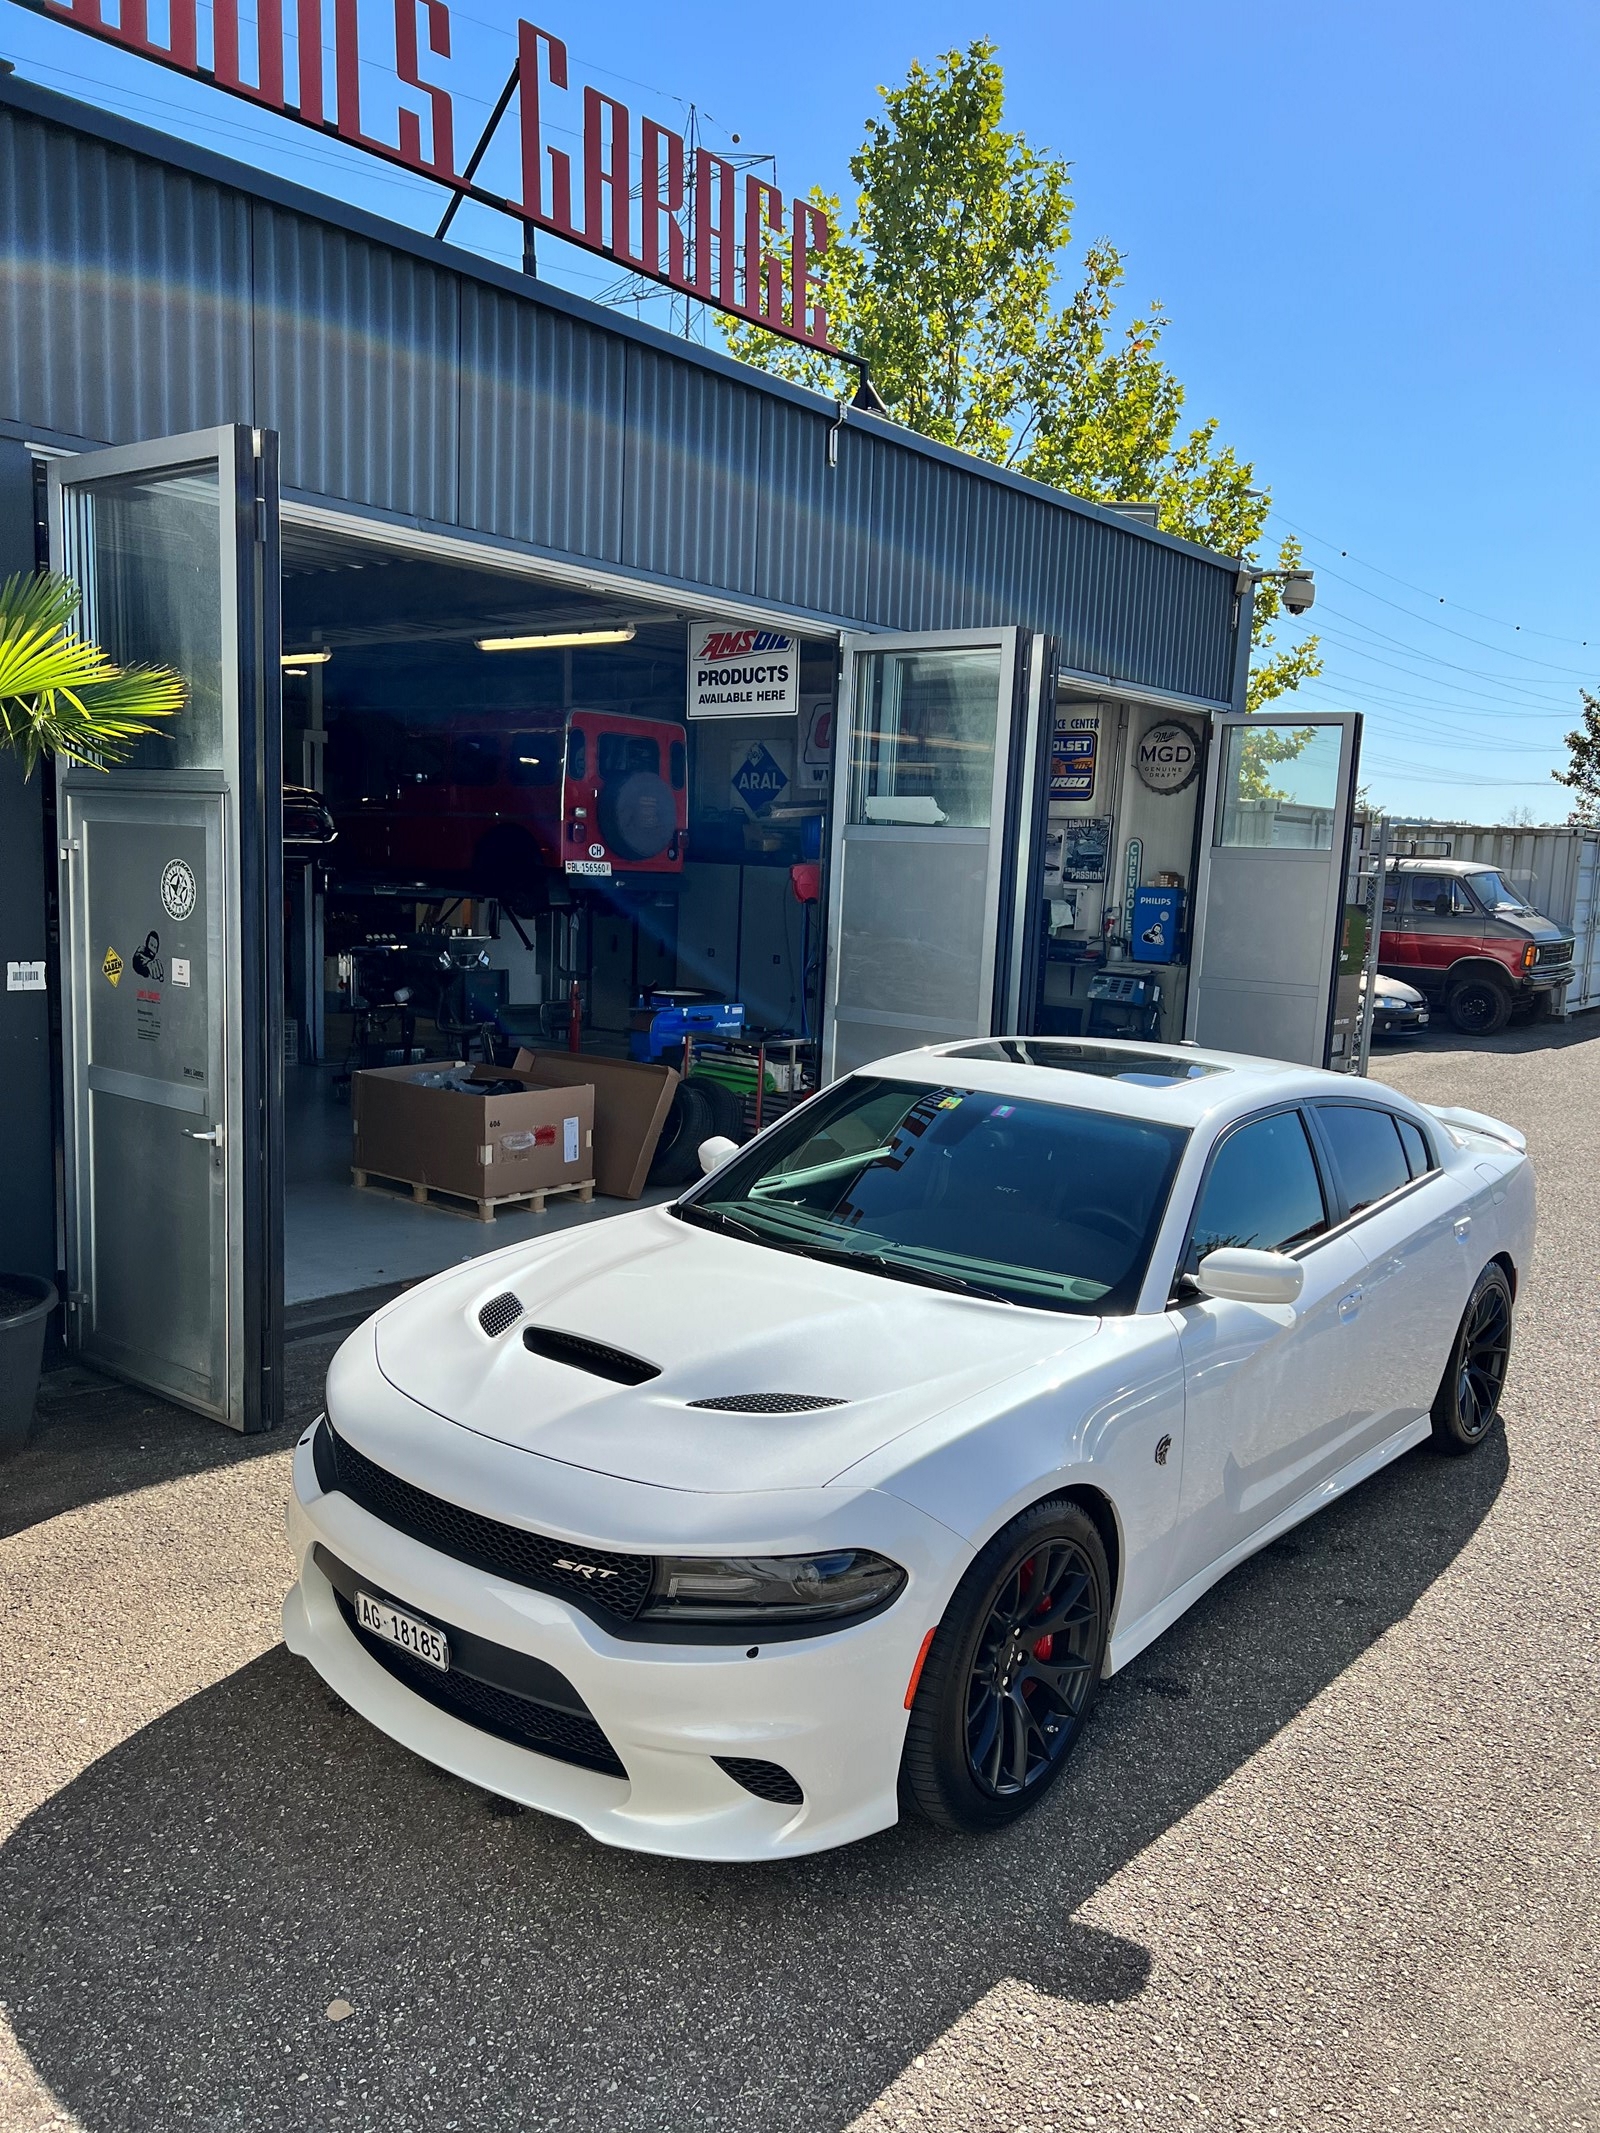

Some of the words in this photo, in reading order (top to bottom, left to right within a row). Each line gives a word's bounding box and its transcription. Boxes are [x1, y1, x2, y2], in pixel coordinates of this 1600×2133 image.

[508, 18, 838, 354] GARAGE
[699, 630, 791, 661] AMSOIL
[697, 665, 789, 686] PRODUCTS
[698, 691, 753, 704] AVAILABLE
[756, 689, 786, 701] HERE
[1070, 718, 1099, 729] CENTER
[1053, 740, 1090, 751] OLSET
[1140, 745, 1191, 762] MGD
[738, 772, 781, 789] ARAL
[591, 845, 602, 856] CH
[1125, 844, 1139, 934] CHEVROLE
[1140, 896, 1171, 906] PHILIPS
[489, 1121, 501, 1129] 606
[552, 1559, 618, 1579] SRT
[363, 1599, 381, 1630] AG
[391, 1615, 441, 1662] 18185
